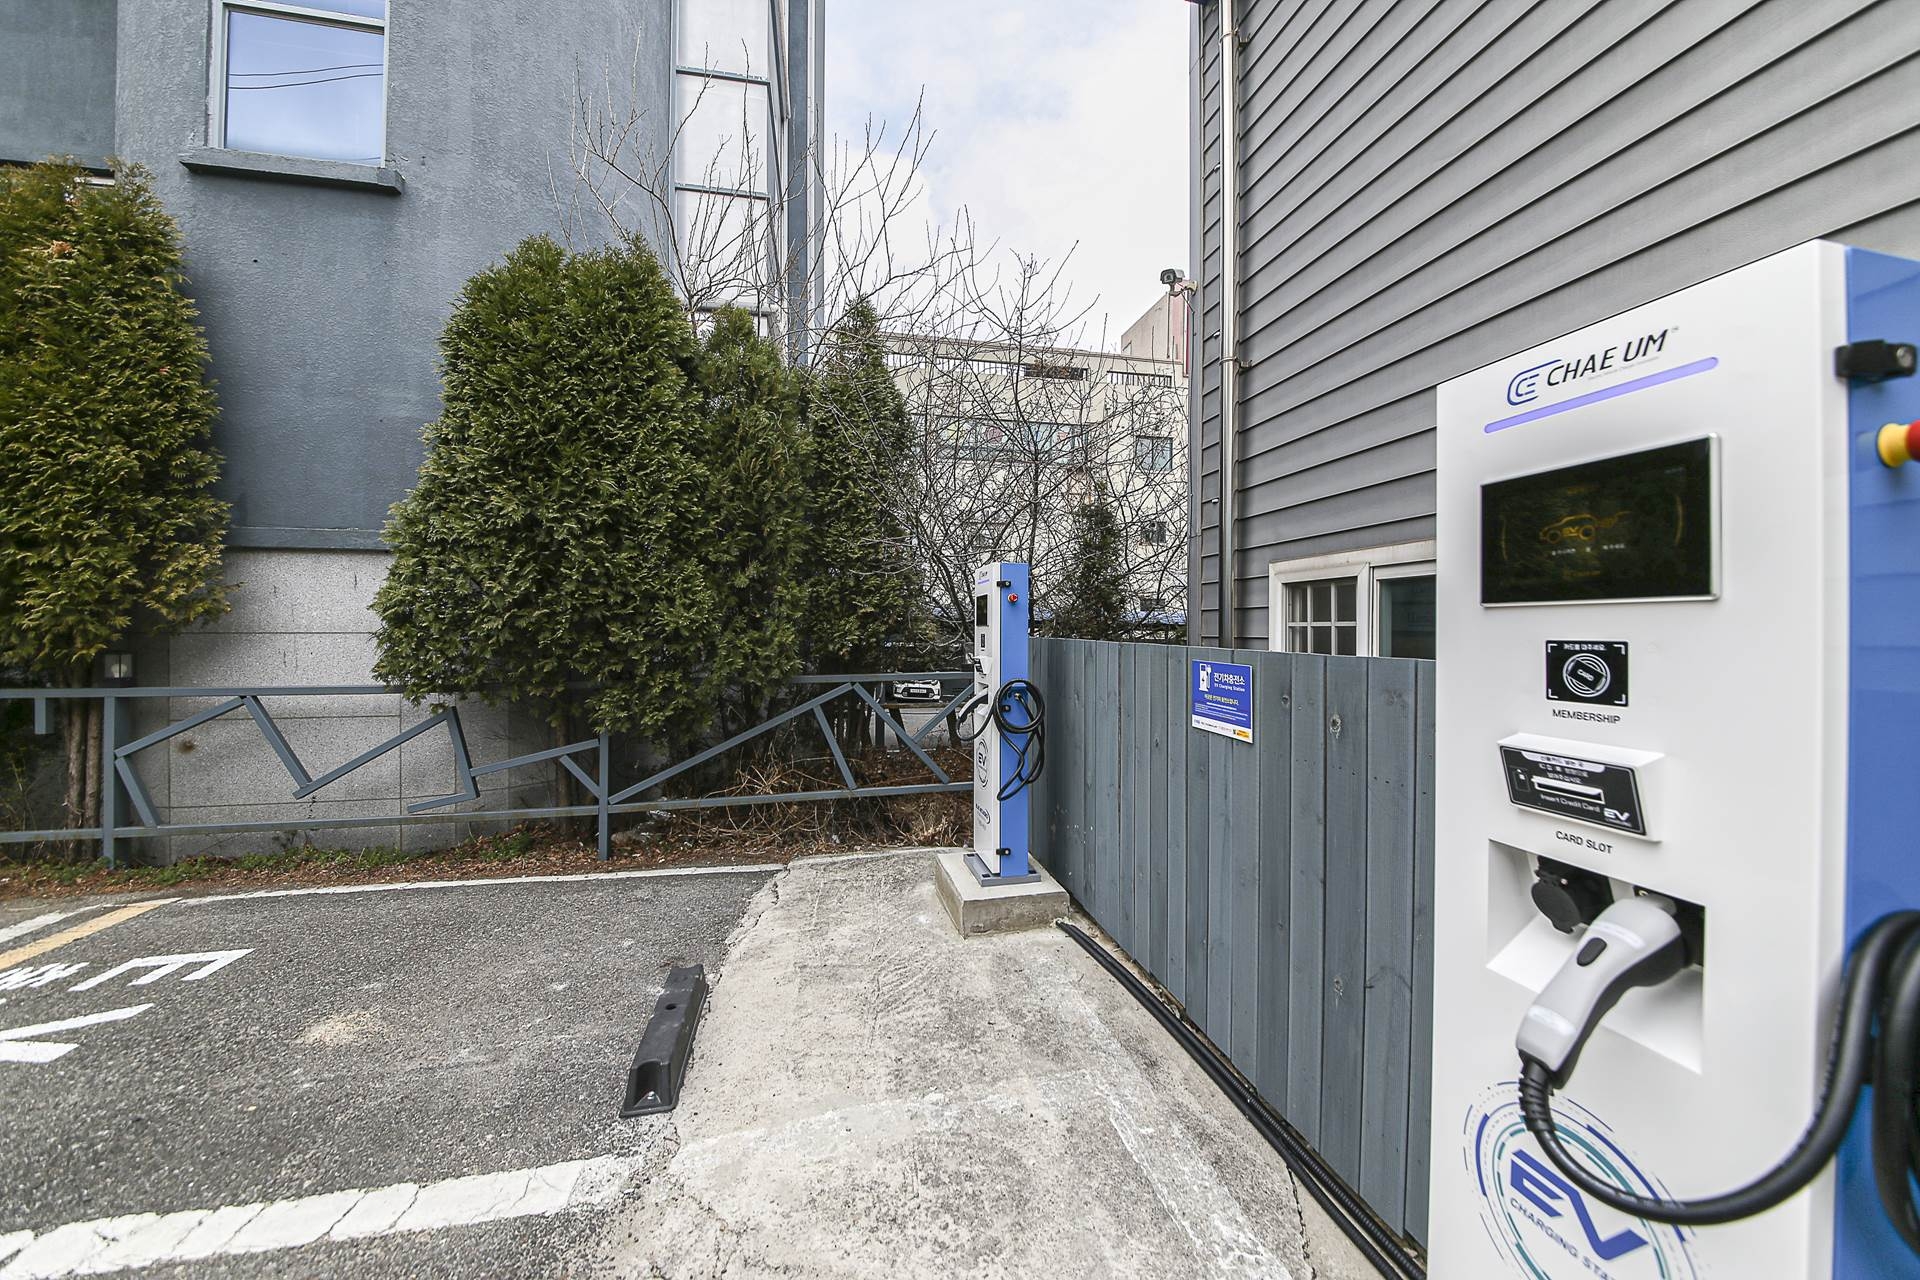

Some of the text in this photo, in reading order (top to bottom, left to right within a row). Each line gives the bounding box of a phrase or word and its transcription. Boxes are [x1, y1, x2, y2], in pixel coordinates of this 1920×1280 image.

[1552, 709, 1621, 724] MEMBERSHIP
[1582, 802, 1600, 813] Card
[1604, 808, 1630, 820] EV
[1555, 830, 1613, 854] CARD SLOT
[1510, 1148, 1649, 1261] EV
[1510, 1198, 1579, 1258] CHARGING
